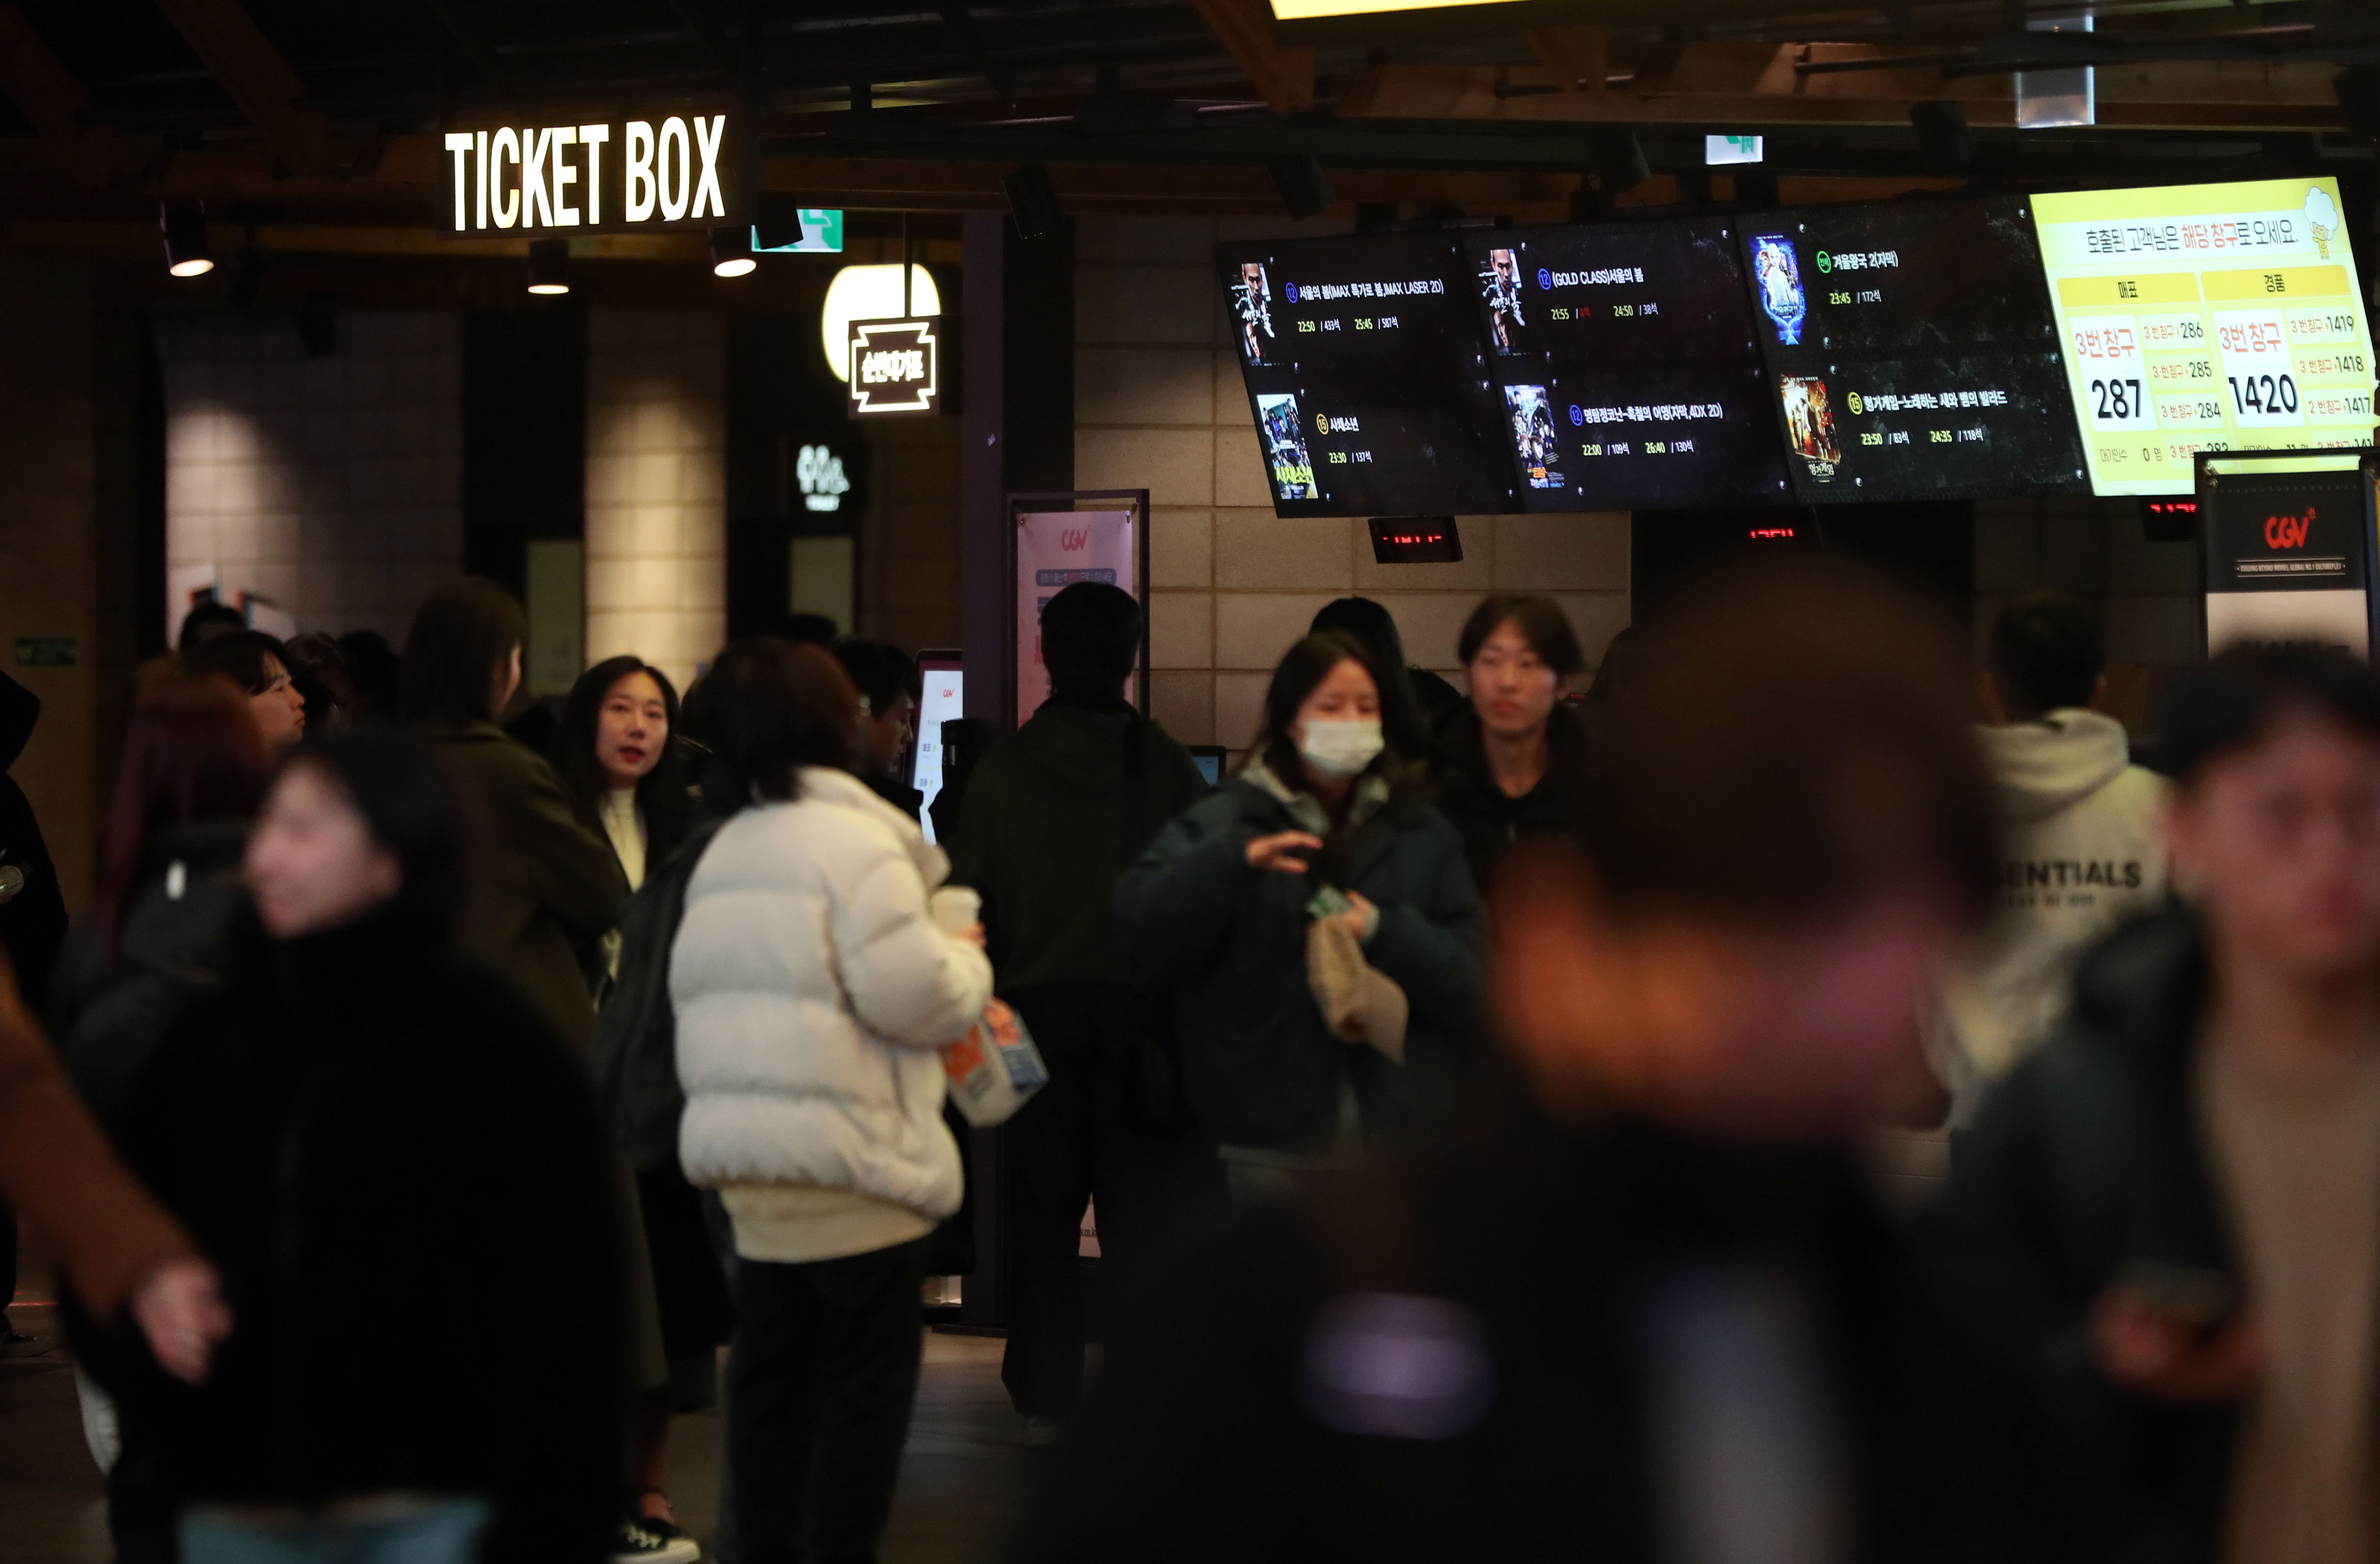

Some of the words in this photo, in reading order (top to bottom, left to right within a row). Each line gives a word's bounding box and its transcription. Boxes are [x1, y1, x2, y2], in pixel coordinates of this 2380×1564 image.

[444, 123, 610, 231] TICKET
[625, 114, 726, 223] BOX
[2086, 229, 2127, 253] 호출된
[2126, 226, 2181, 252] 고객님은
[2181, 224, 2209, 250] 해당
[2210, 222, 2252, 249] 창구로
[2253, 219, 2299, 245] 오세요.
[1832, 253, 1867, 270] 겨울왕국
[1869, 250, 1899, 268] 2(자막)
[1552, 271, 1578, 287] (GOLD
[1634, 267, 1644, 283] 봄
[2264, 274, 2286, 293] 경품
[1300, 285, 1321, 300] 서울의
[1321, 284, 1351, 300] 봄(IMAX
[1350, 283, 1374, 298] 특가로
[1403, 281, 1430, 294] LASER
[1430, 278, 1444, 295] 2D)
[2118, 281, 2139, 299] 매표
[1829, 292, 1851, 305] 23:45
[1551, 309, 1569, 320] 21:55
[1613, 305, 1633, 317] 24:50
[1297, 320, 1316, 332] 22:50
[1354, 318, 1373, 330] 25:45
[2181, 322, 2204, 339] 286
[2327, 316, 2354, 333] 1419
[861, 349, 924, 383] 순번대기표
[2189, 362, 2212, 378] 285
[2336, 356, 2364, 372] 1418
[1864, 394, 1939, 412] 헝거게임-노래하는
[1940, 392, 1959, 408] 새와
[1959, 391, 1979, 407] 뱀의
[1979, 390, 2008, 407] 발라드
[2092, 379, 2141, 419] 287
[2228, 374, 2299, 415] 1420
[1707, 401, 1723, 419] 2D)
[2198, 402, 2221, 418] 284
[2345, 397, 2371, 414] 1417
[1861, 433, 1883, 445] 23:50
[1930, 430, 1953, 443] 24:35
[1582, 444, 1602, 456] 22:00
[1645, 442, 1666, 454] 26:40
[2099, 448, 2128, 462] 대기인수
[2143, 448, 2150, 462] 0
[2154, 447, 2163, 461] 명
[1329, 452, 1347, 464] 23:30
[1061, 529, 1088, 551] CGV
[2265, 516, 2310, 549] CGV
[2002, 860, 2142, 888] ENTIALS
